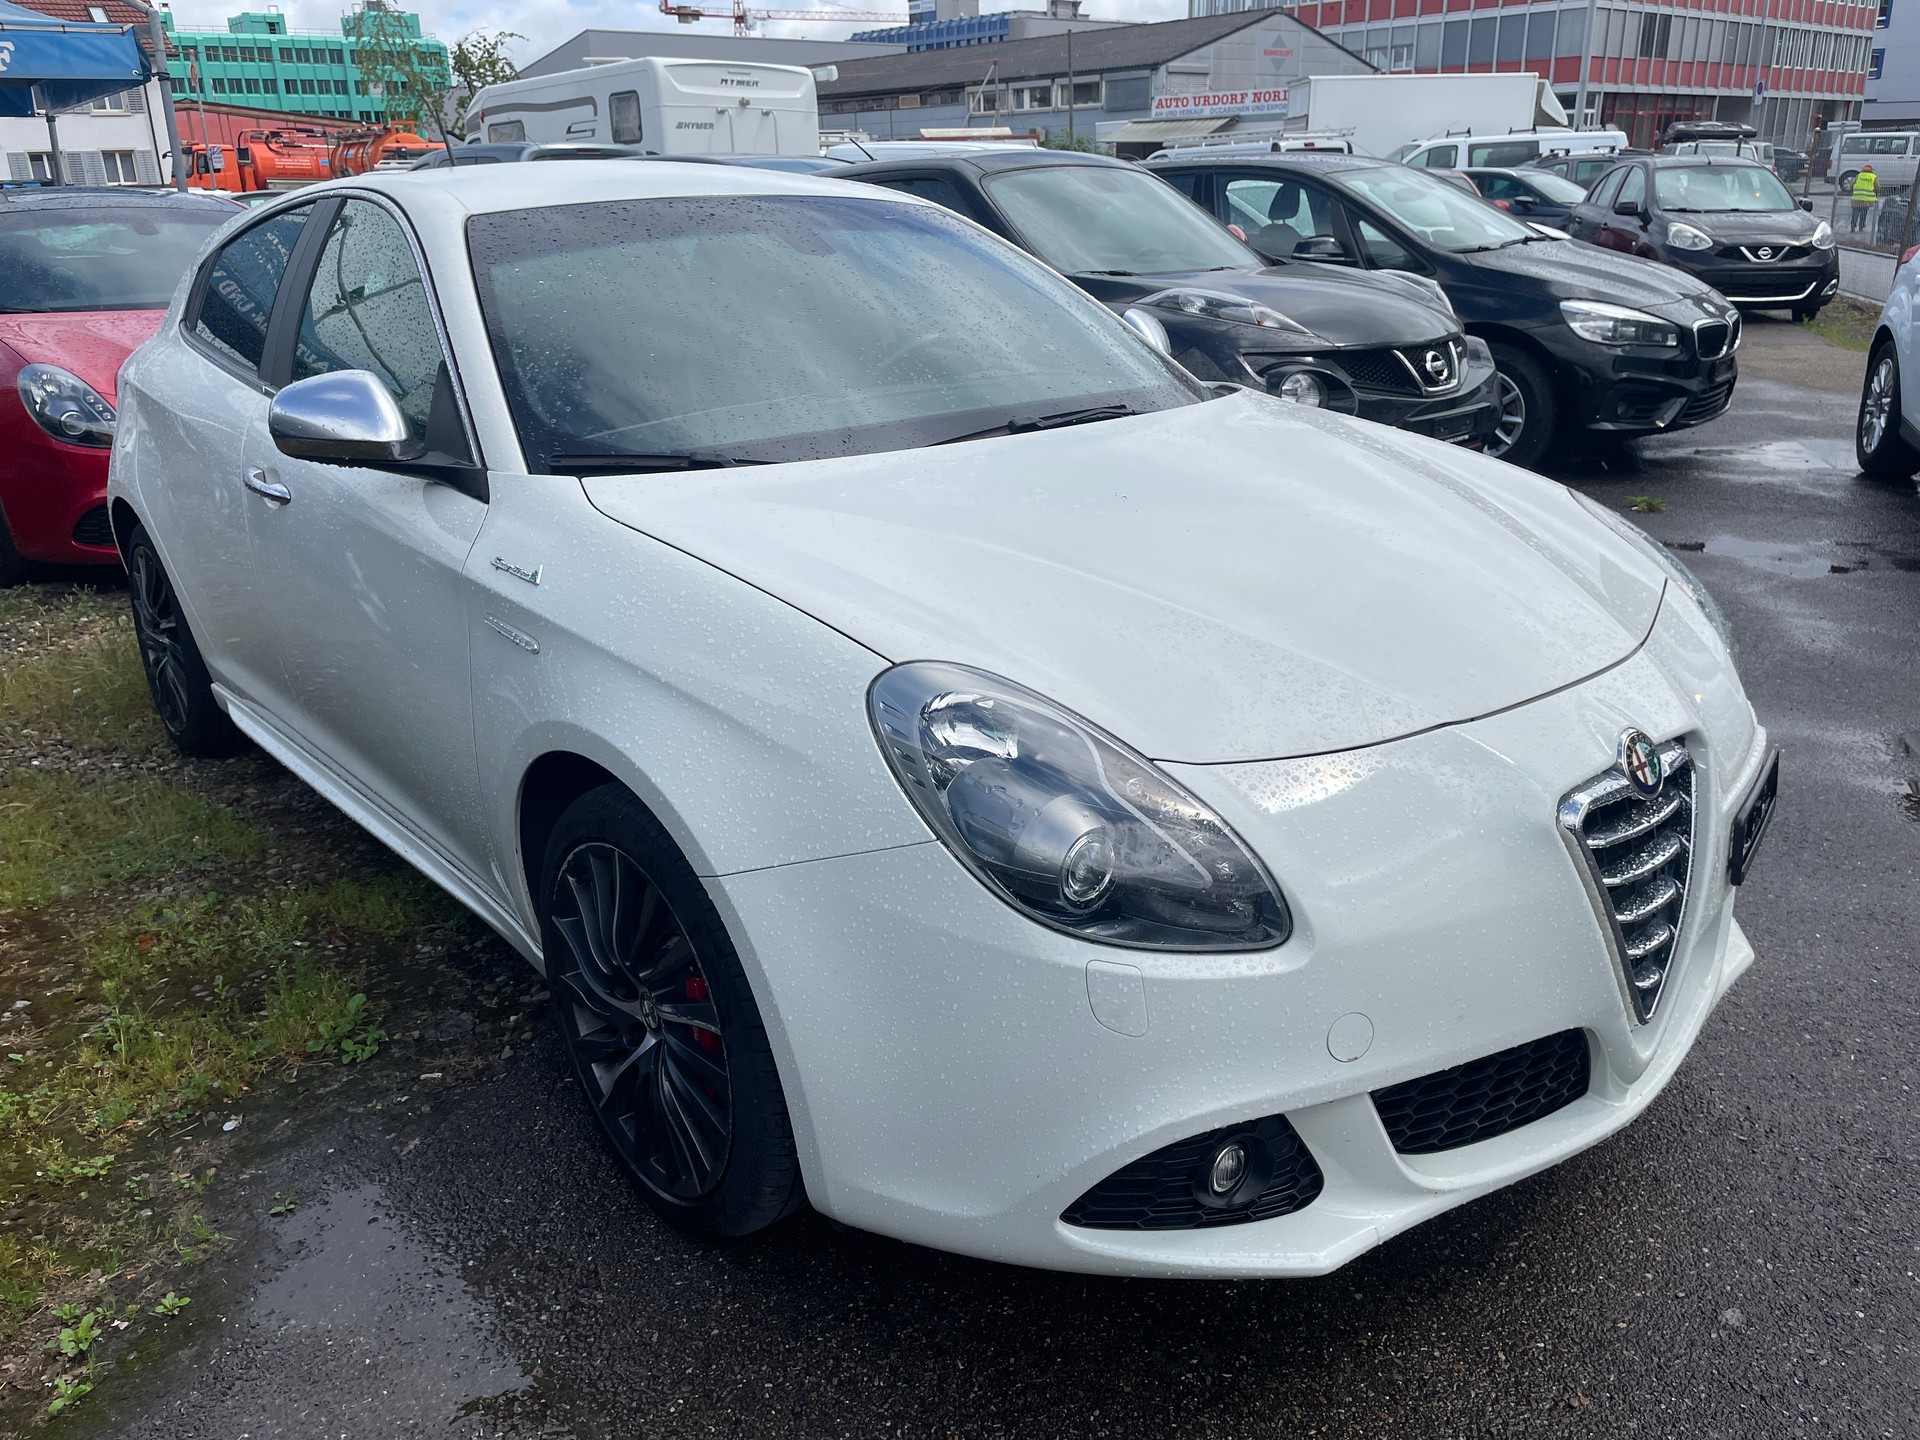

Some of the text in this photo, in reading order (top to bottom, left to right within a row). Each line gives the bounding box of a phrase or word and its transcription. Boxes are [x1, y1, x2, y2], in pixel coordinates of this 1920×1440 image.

[1155, 96, 1189, 109] AUTO
[1192, 92, 1248, 107] URDORF
[1165, 109, 1177, 117] UND
[1179, 107, 1204, 116] VERKAUF
[1250, 104, 1266, 112] UND
[683, 122, 715, 130] HYMER
